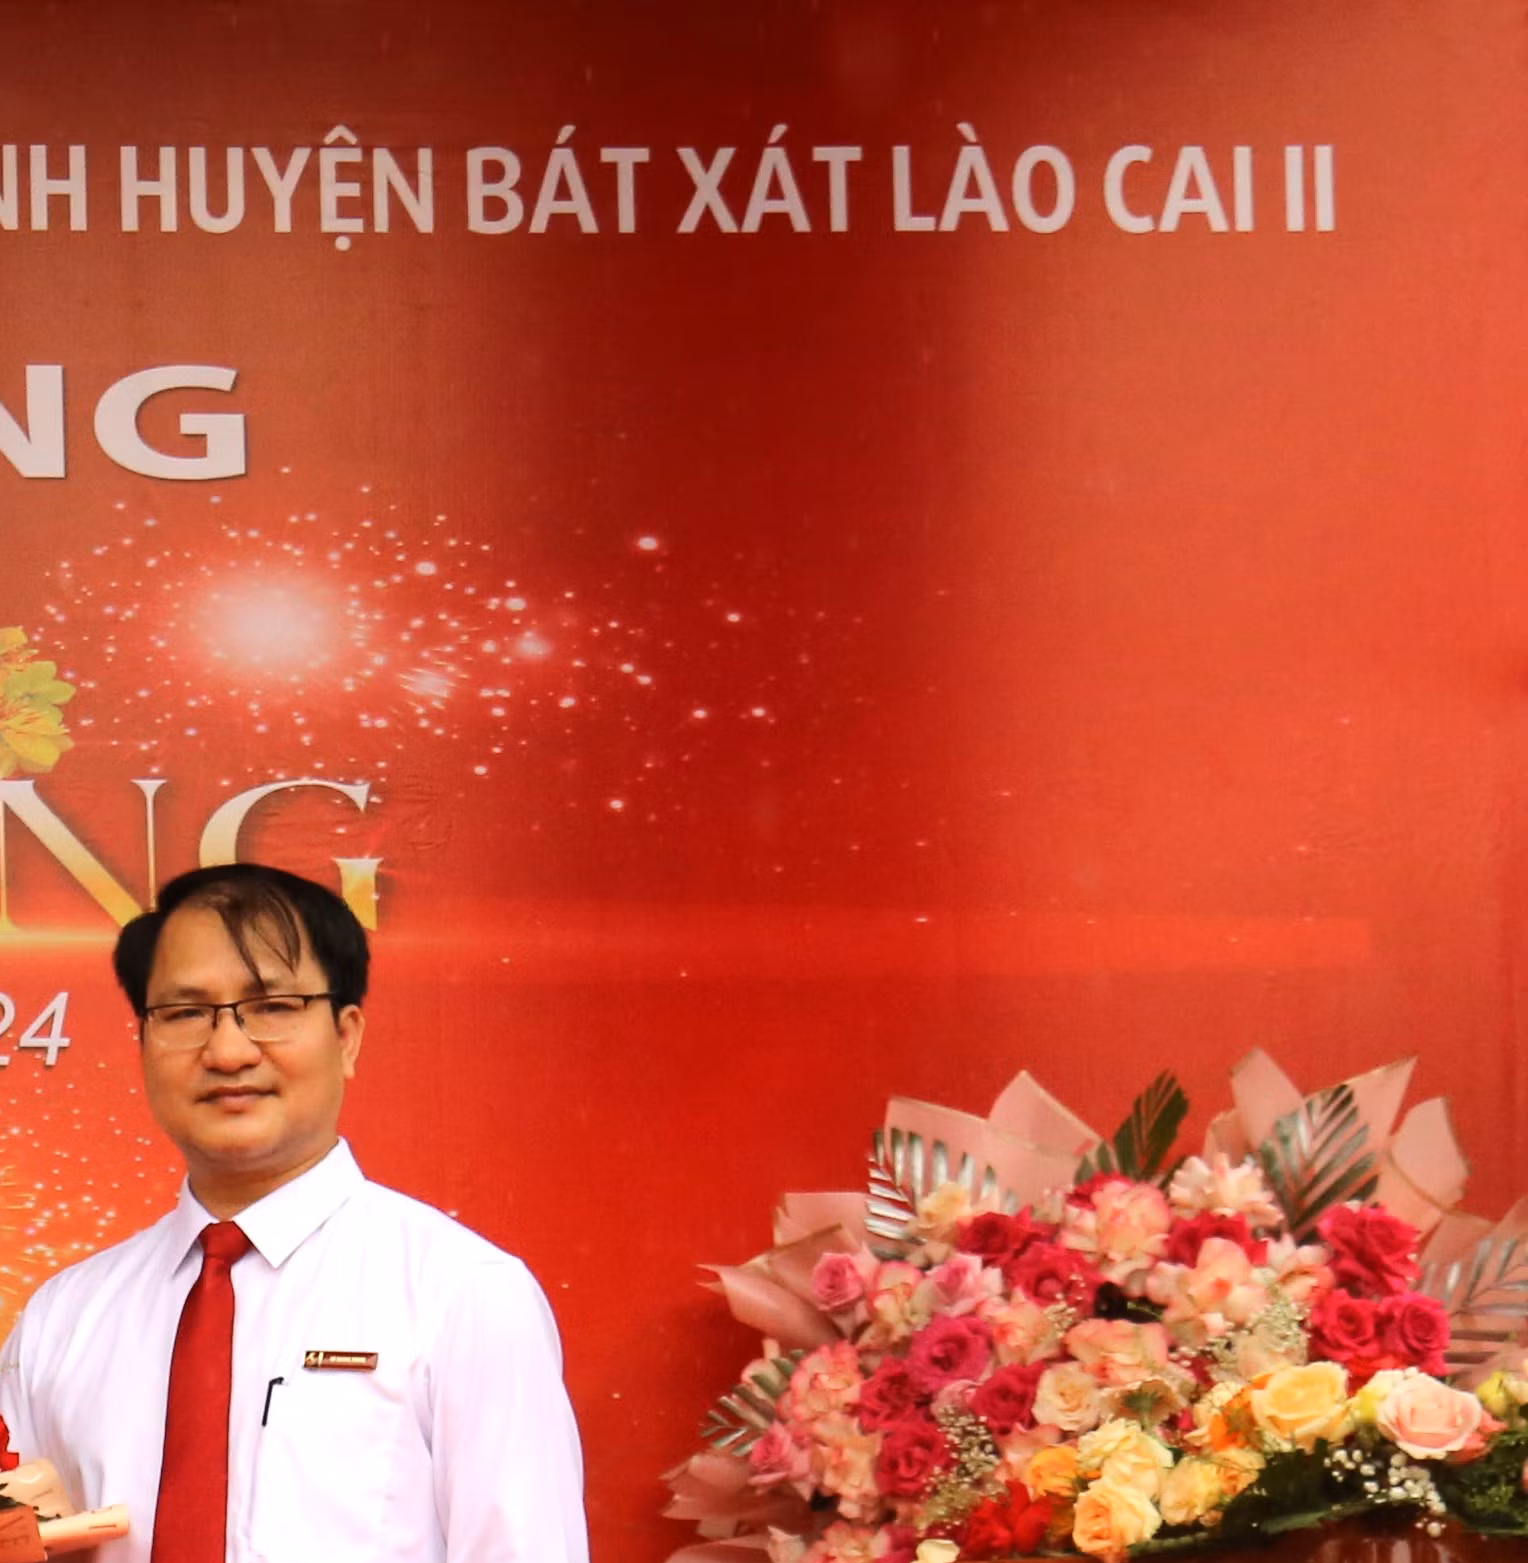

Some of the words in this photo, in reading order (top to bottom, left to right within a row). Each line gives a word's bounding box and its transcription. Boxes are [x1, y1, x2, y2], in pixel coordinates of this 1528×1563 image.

[116, 126, 435, 251] HUYỆN
[466, 125, 649, 236] BÁT
[677, 124, 861, 234] XÁT
[891, 122, 1076, 236] LÀO
[1101, 143, 1252, 235] CAI
[1284, 144, 1336, 233] II
